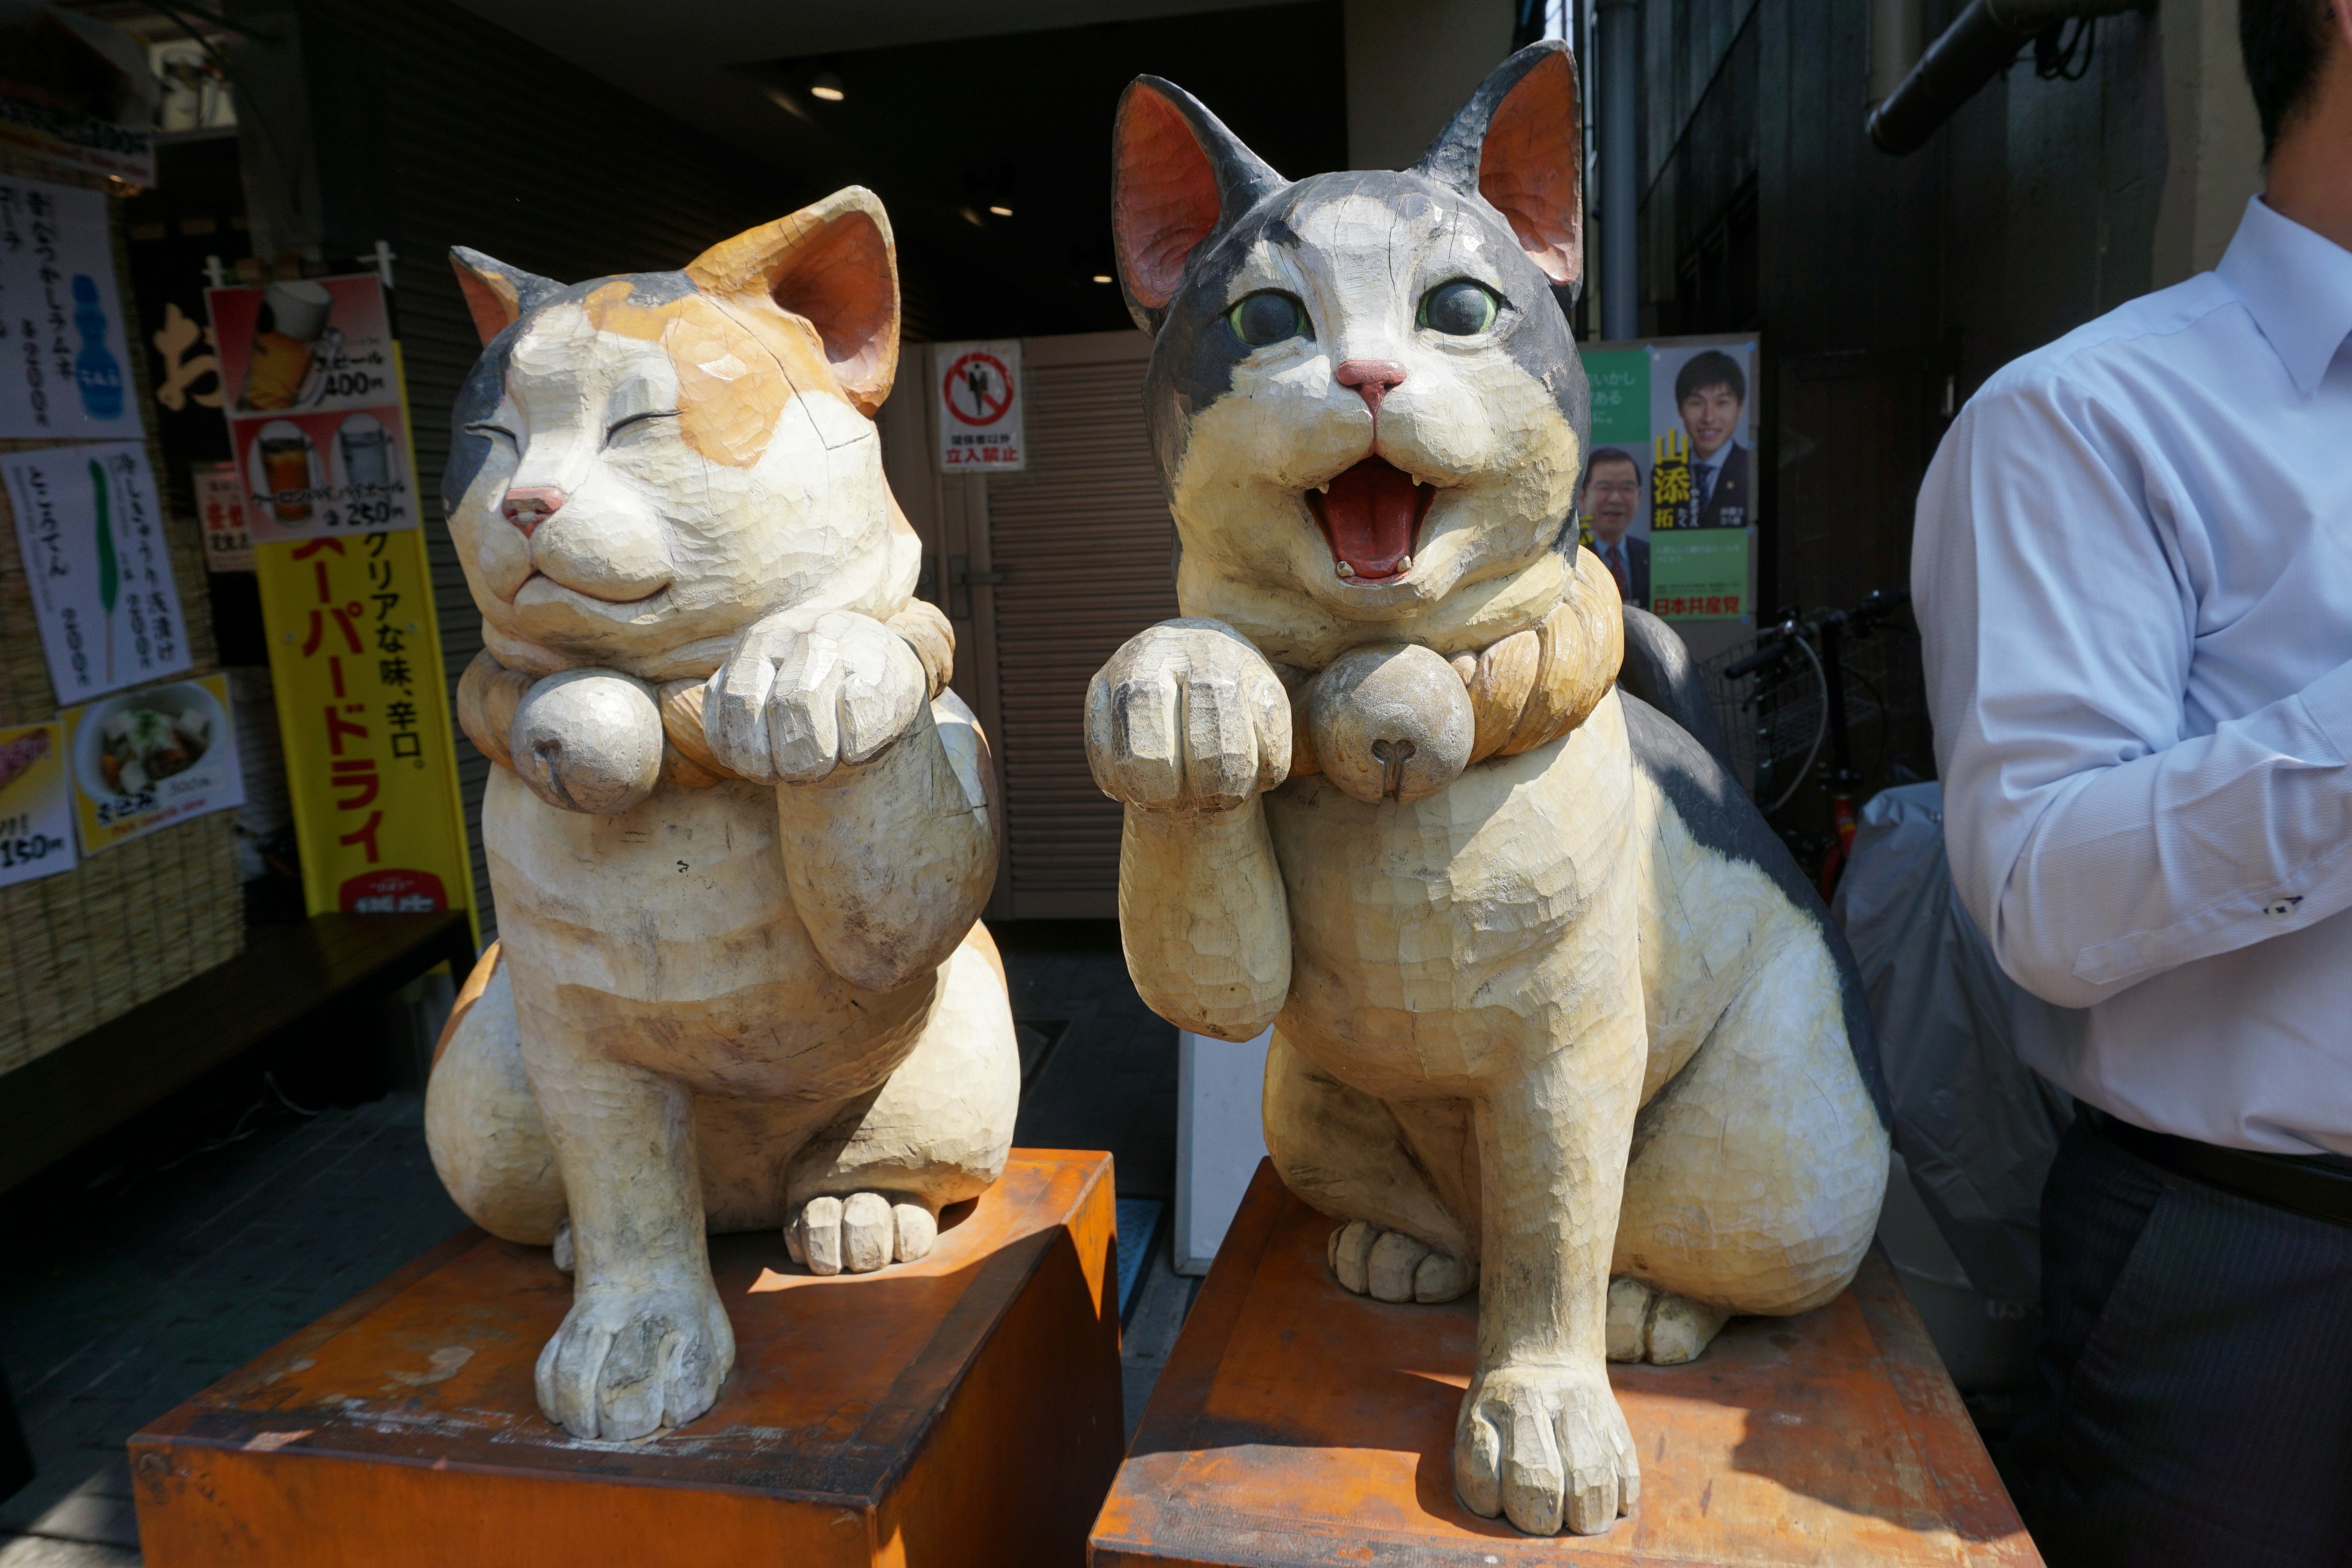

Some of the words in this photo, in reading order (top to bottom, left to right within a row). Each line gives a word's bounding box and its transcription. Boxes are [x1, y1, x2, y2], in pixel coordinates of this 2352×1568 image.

[946, 447, 1019, 464] 立入禁止
[1654, 596, 1741, 616] 日本共産党
